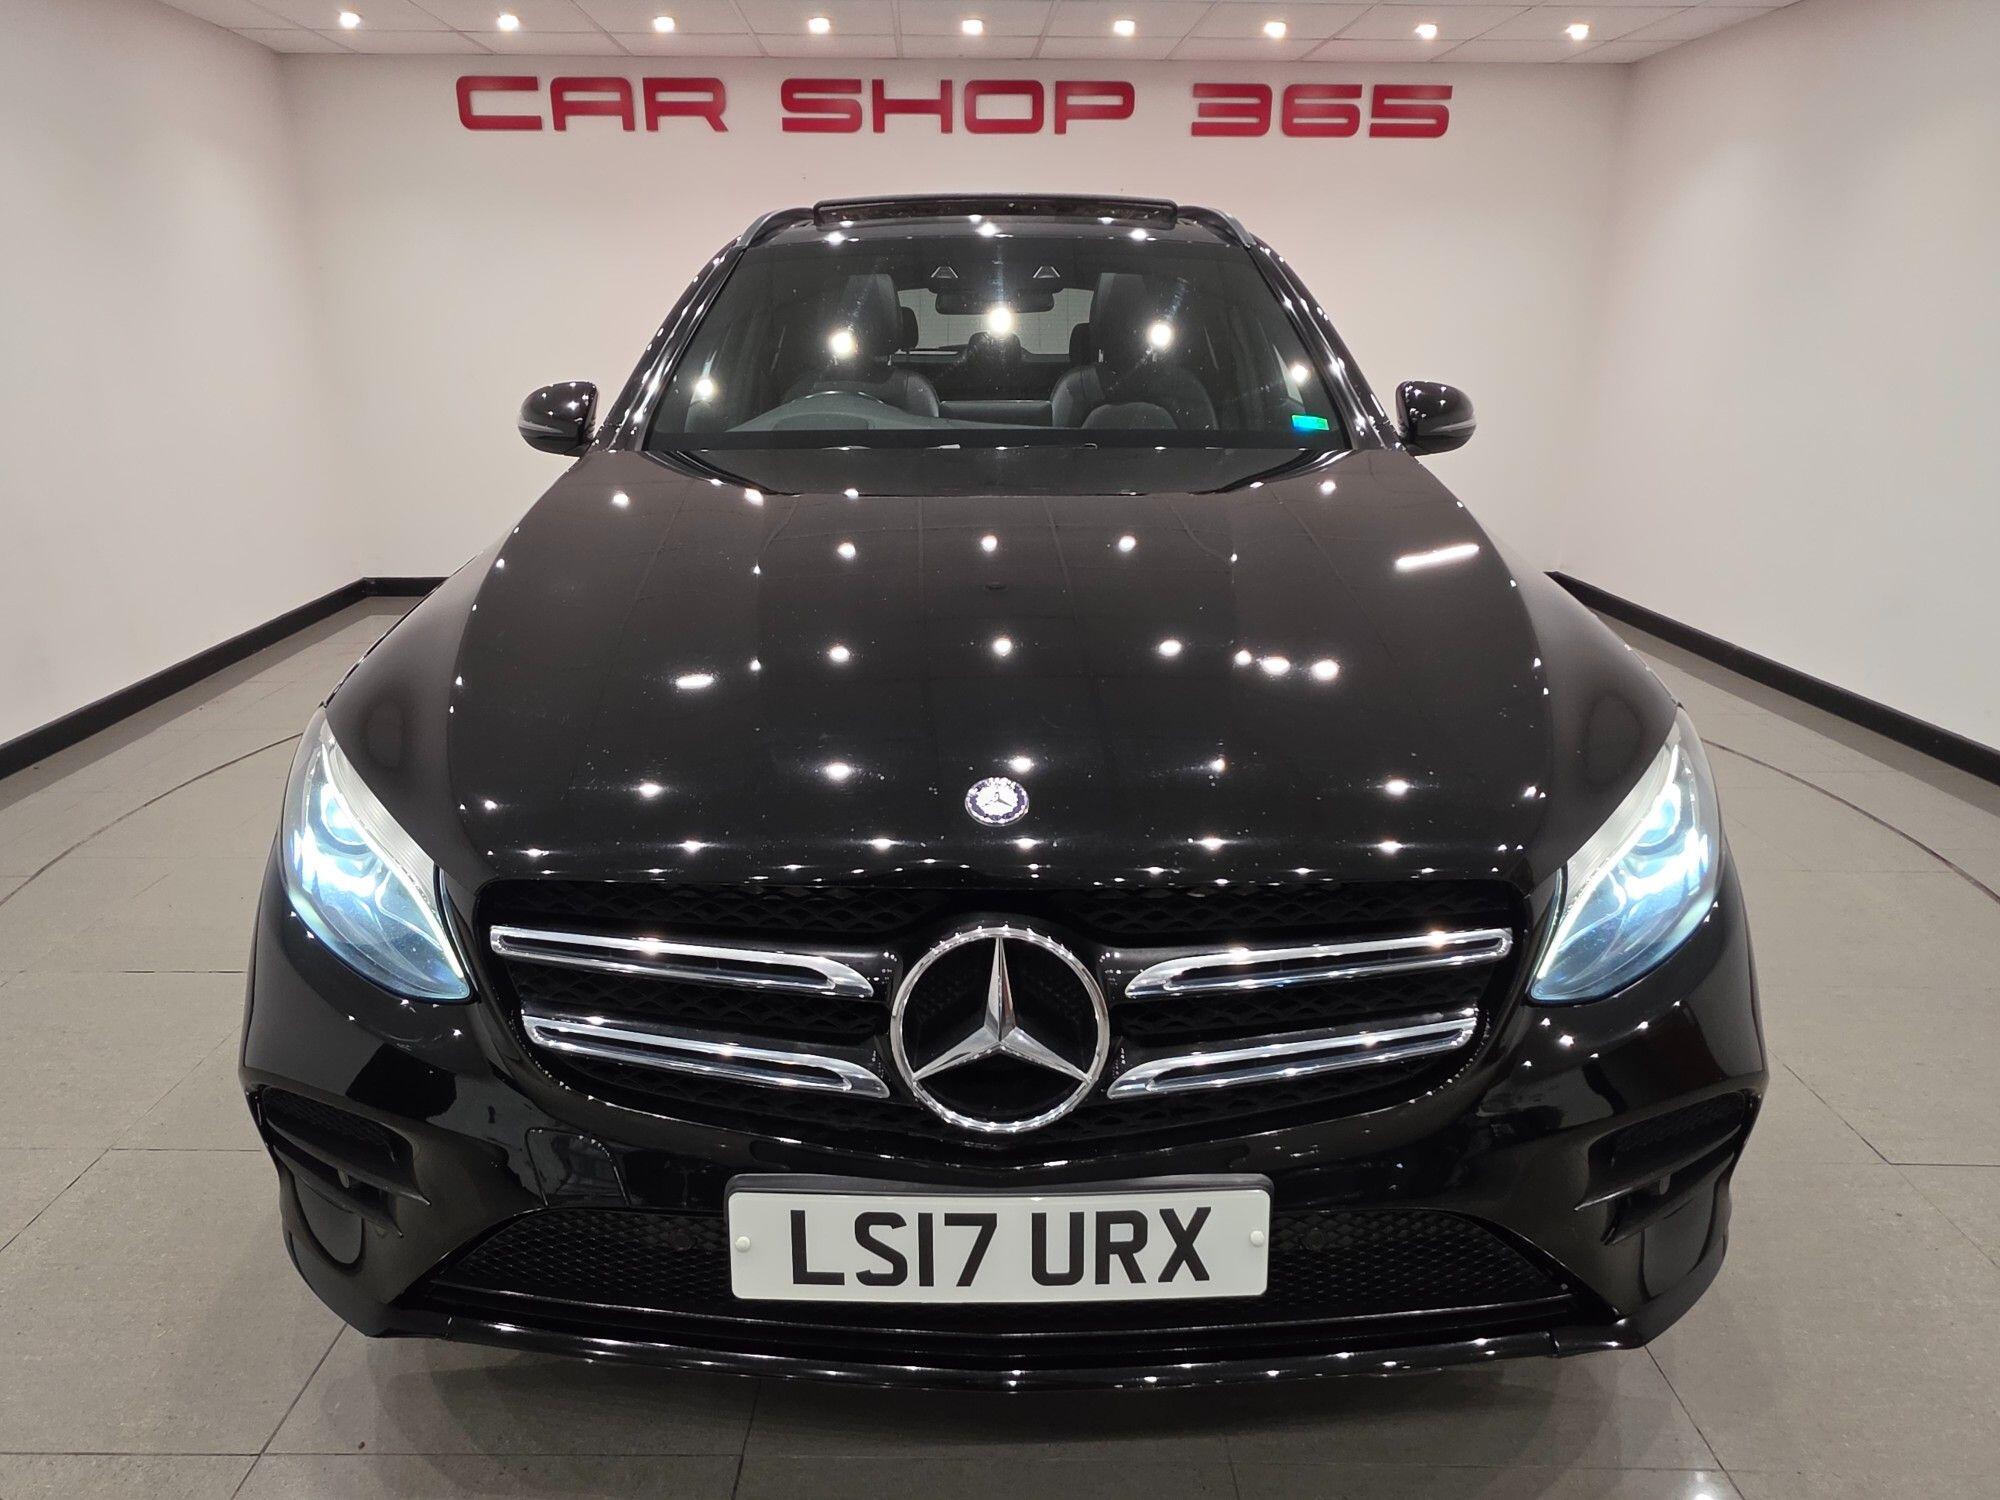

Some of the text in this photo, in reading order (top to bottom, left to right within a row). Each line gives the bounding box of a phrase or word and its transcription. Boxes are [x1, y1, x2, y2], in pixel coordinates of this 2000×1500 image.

[456, 76, 1452, 138] CAR SHOP 365
[790, 1206, 1212, 1288] LS17 URX
